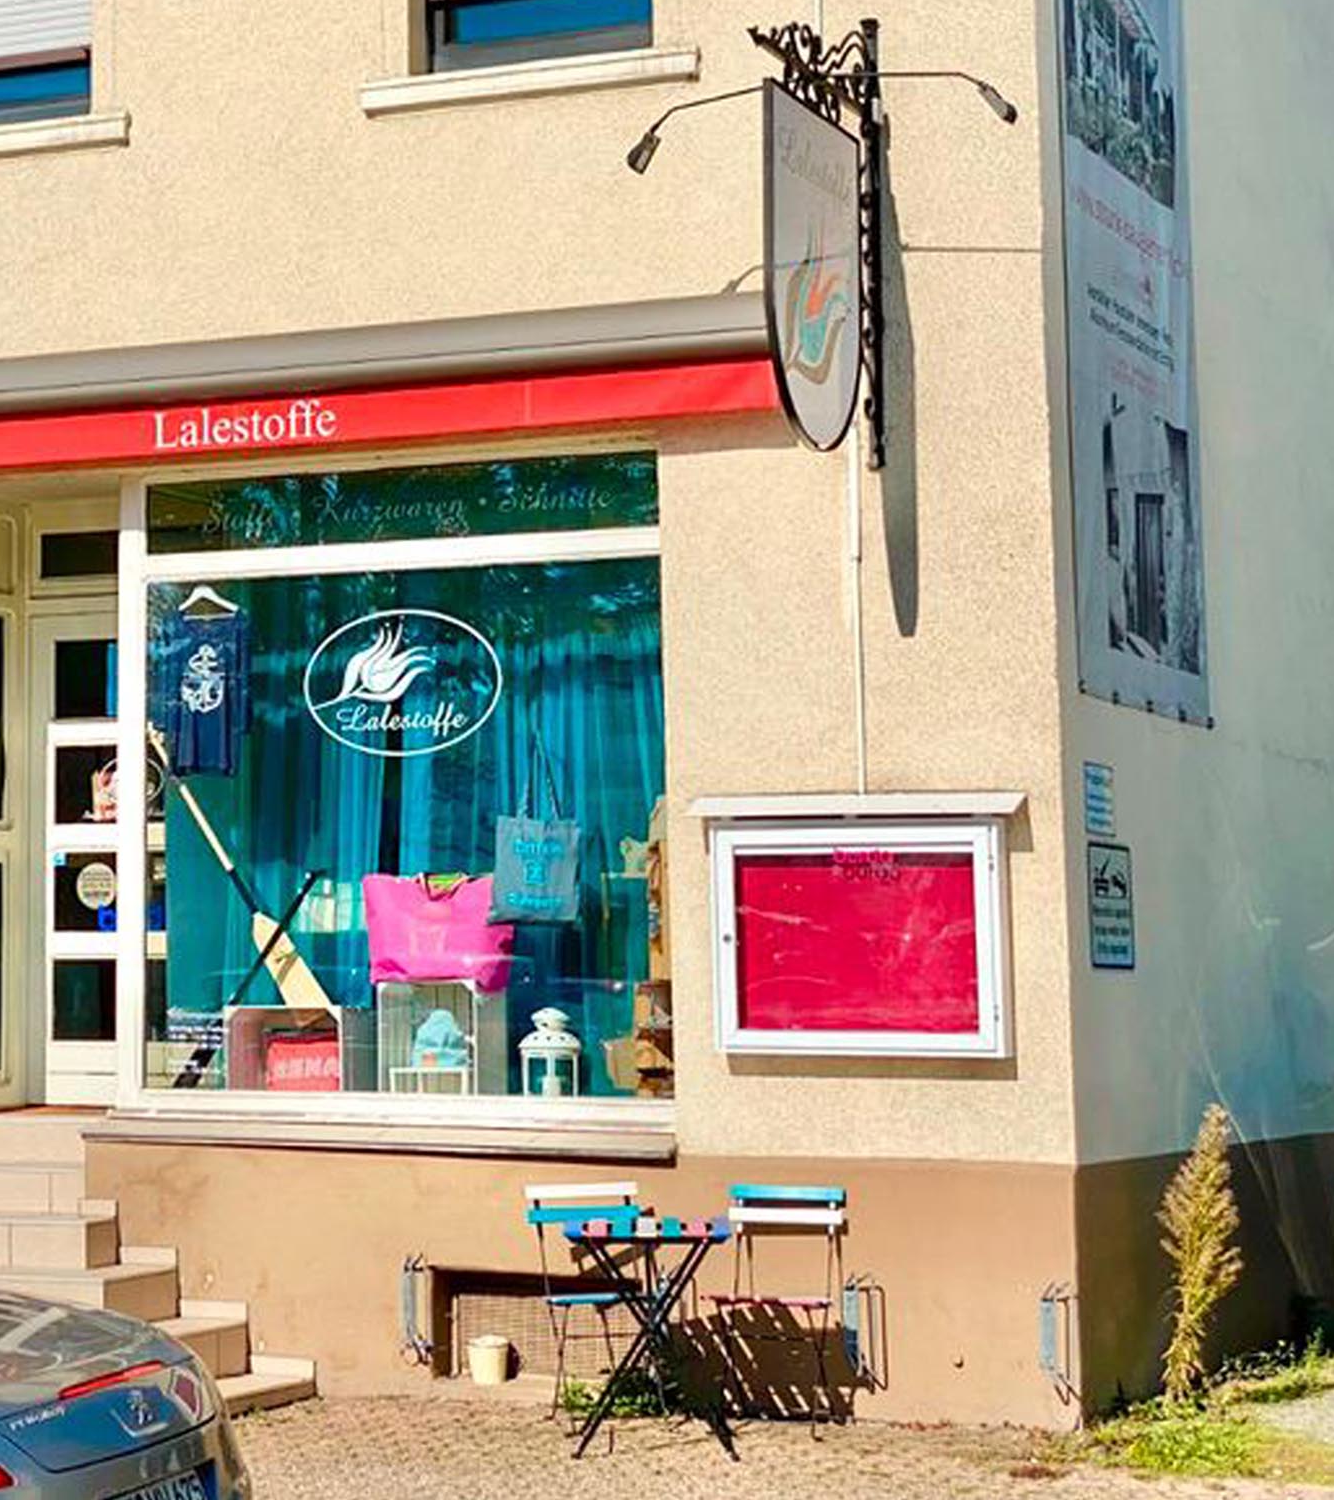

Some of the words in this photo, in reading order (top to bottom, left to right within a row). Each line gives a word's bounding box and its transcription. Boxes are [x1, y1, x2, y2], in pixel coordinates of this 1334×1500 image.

[154, 400, 338, 449] Lalestoffe
[314, 495, 468, 531] Kurzwaren
[336, 701, 470, 737] Lalestoffe
